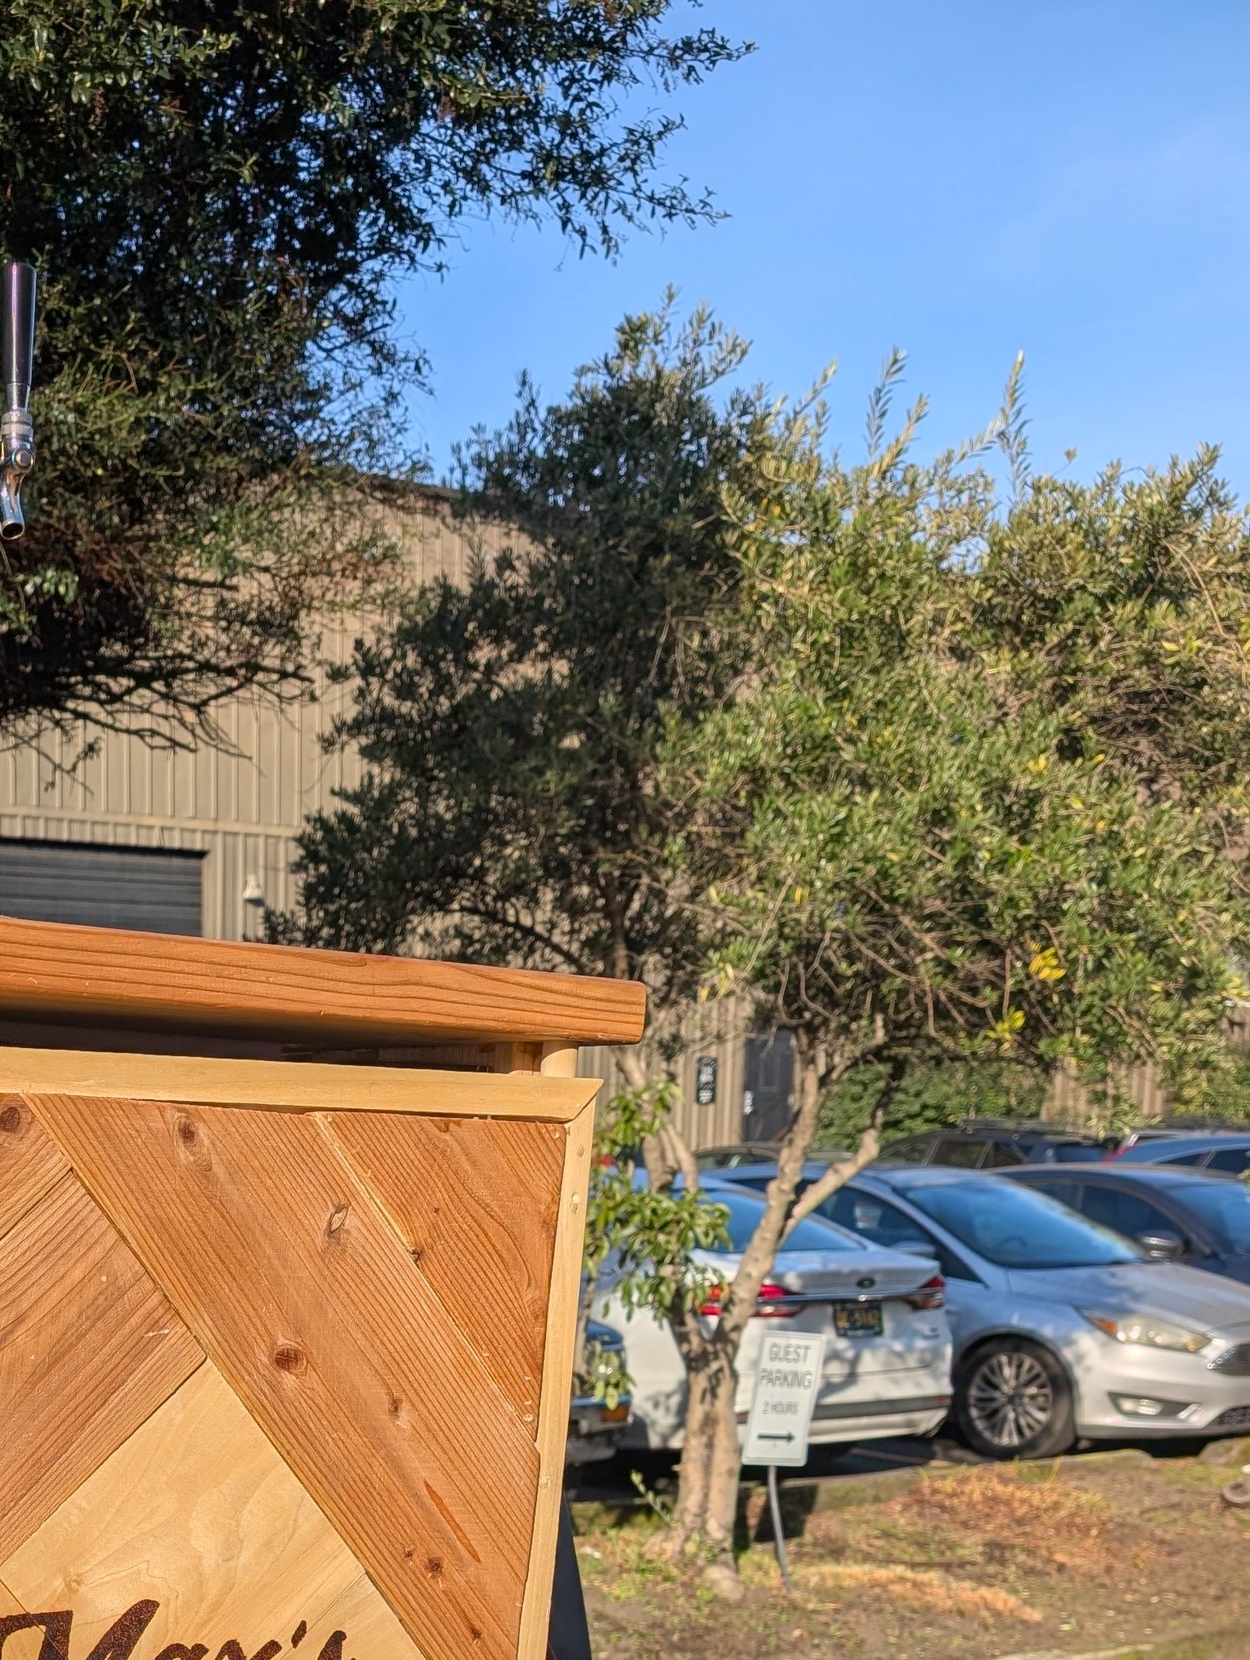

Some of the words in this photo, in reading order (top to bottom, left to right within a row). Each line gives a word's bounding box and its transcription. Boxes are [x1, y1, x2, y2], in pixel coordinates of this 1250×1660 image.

[769, 1342, 812, 1364] GUEST
[760, 1368, 813, 1390] PARKING
[762, 1401, 771, 1415] 2
[771, 1401, 799, 1416] HOURS
